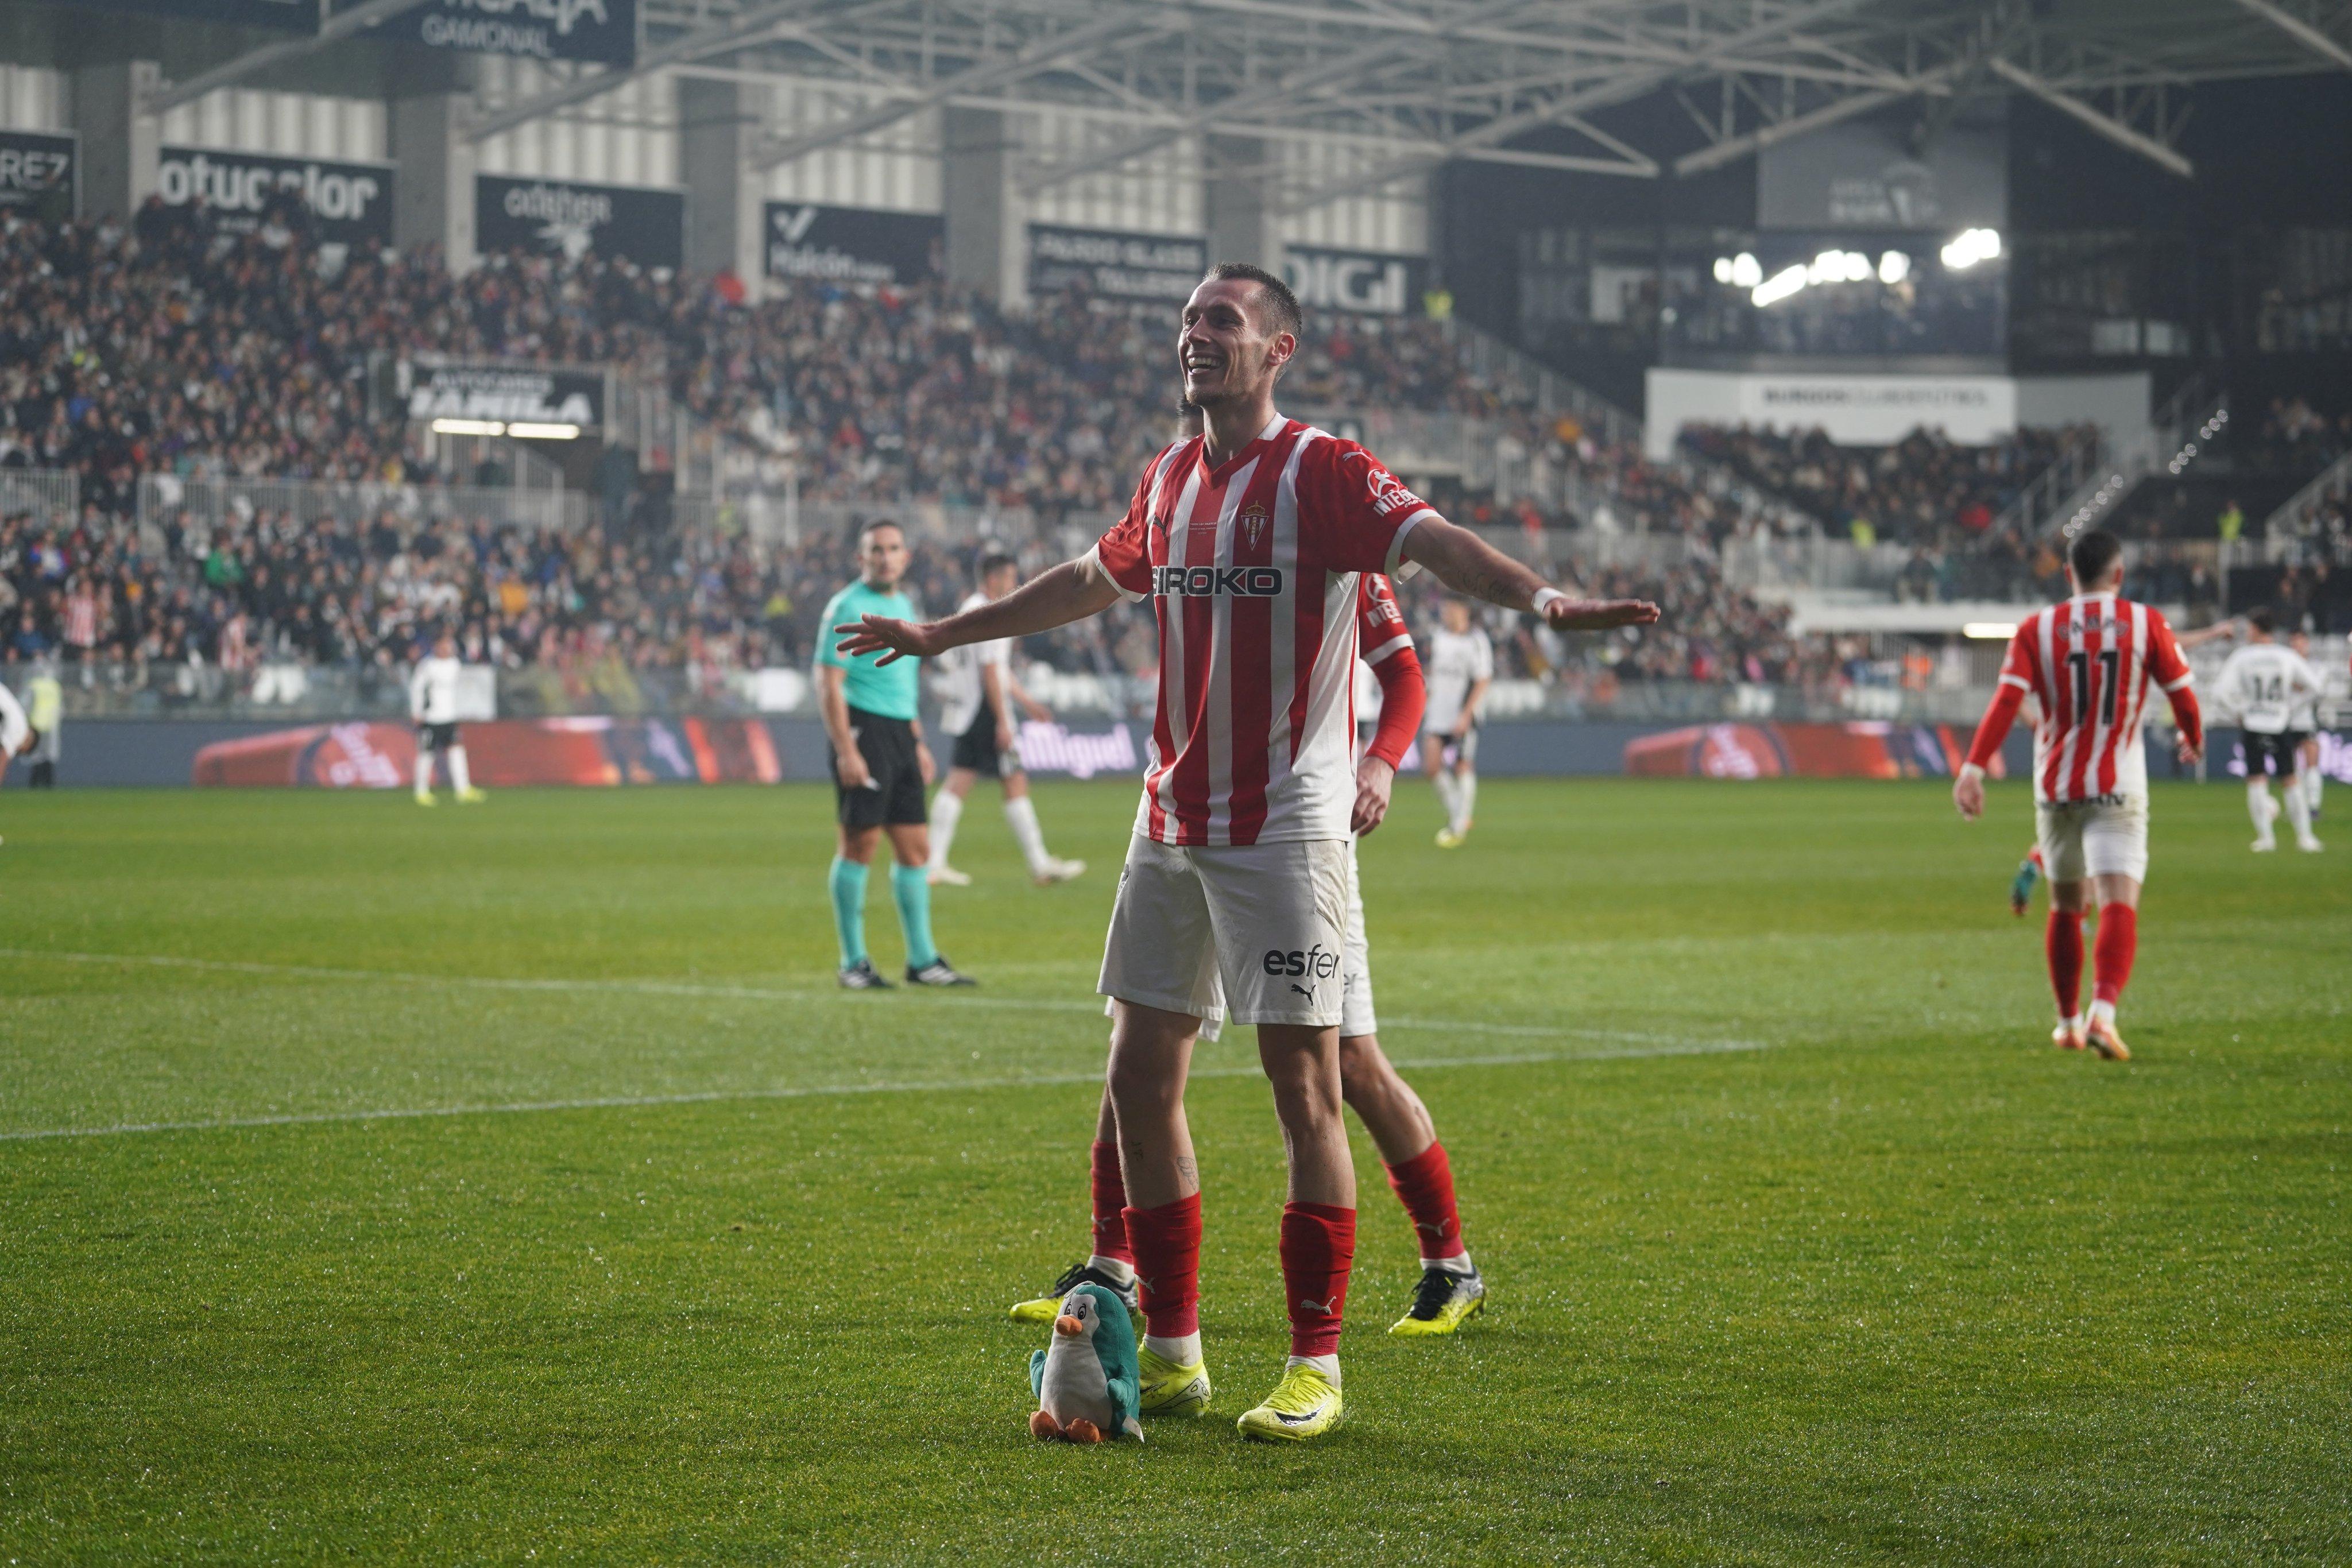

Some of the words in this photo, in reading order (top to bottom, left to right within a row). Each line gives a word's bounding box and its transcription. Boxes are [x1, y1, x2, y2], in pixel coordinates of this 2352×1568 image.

[1271, 255, 1406, 313] DIGI
[2065, 650, 2118, 727] 11
[2253, 672, 2285, 702] 14
